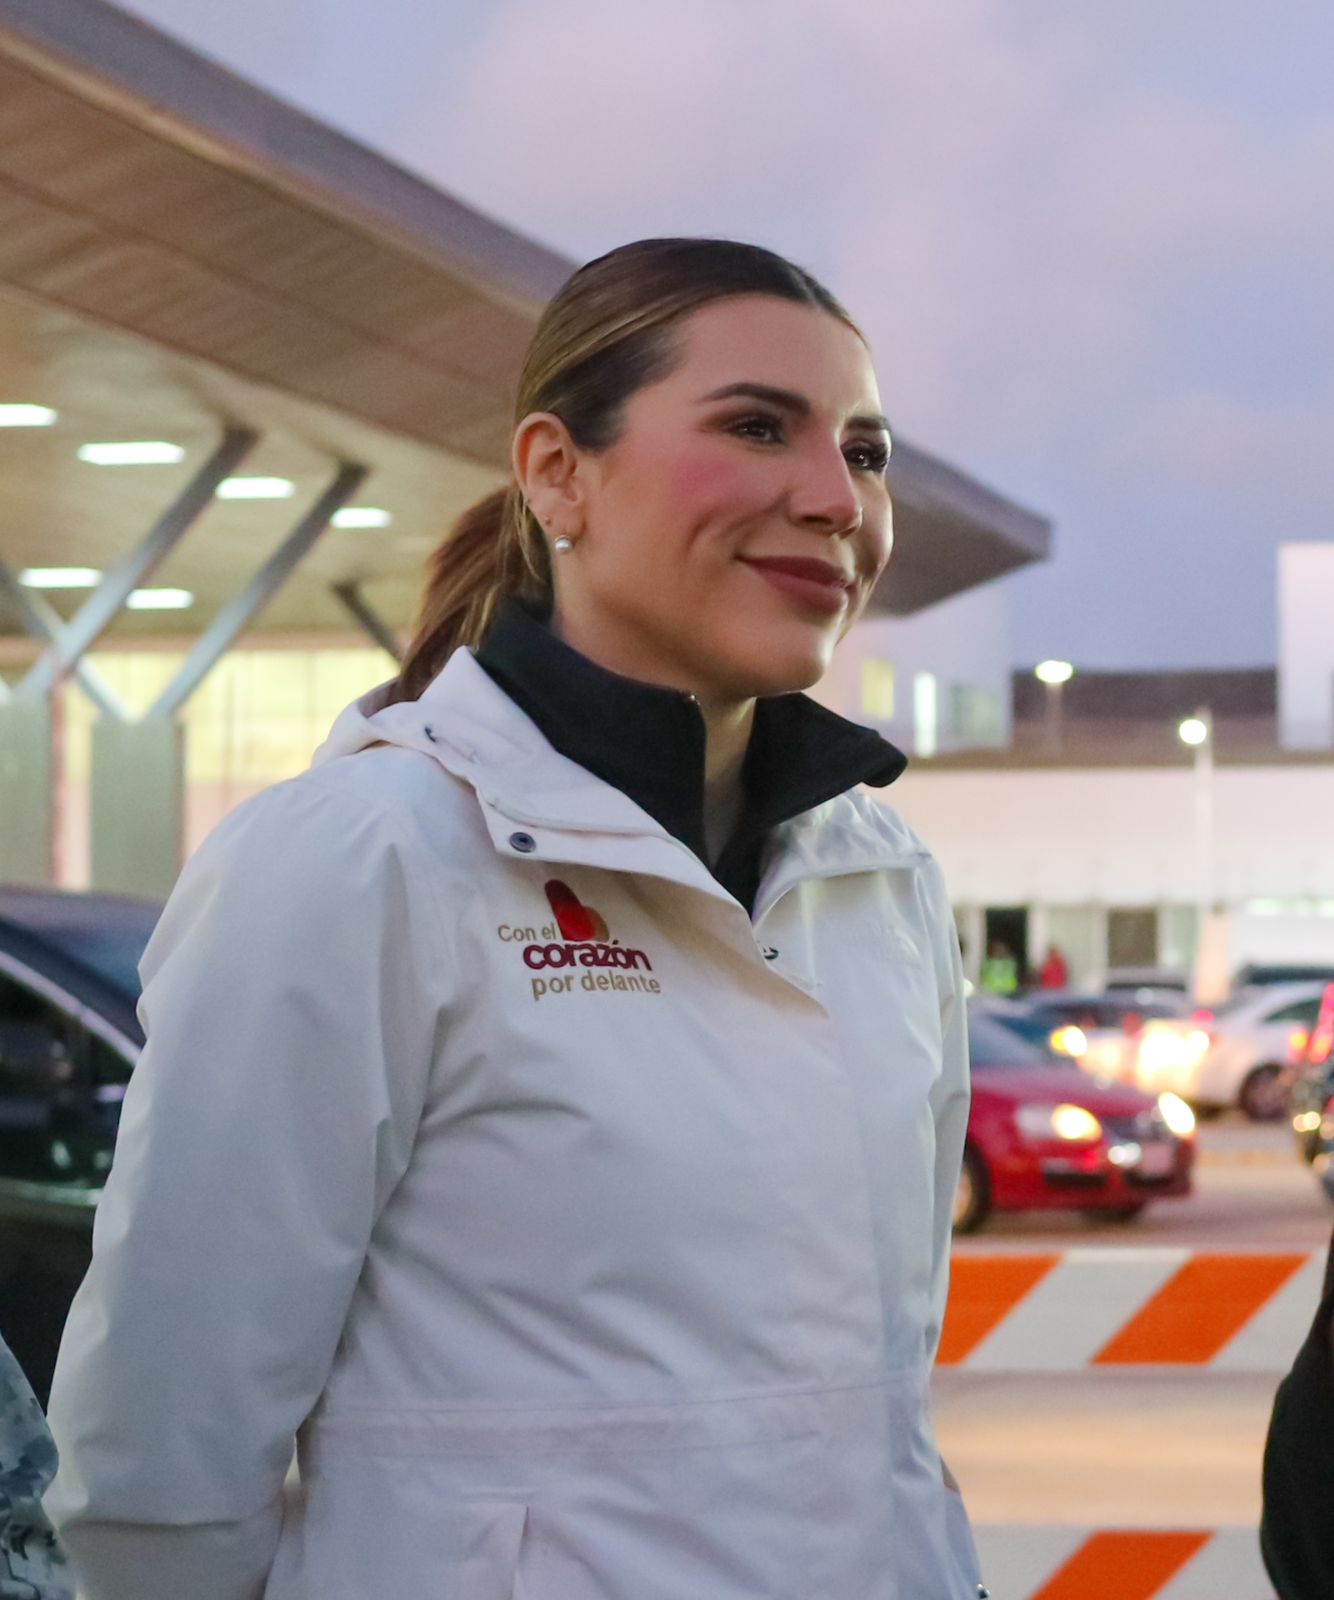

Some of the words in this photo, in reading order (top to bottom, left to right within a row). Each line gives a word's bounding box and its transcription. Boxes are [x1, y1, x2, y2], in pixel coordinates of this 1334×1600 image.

[497, 924, 537, 942] Con
[541, 922, 556, 940] el
[522, 939, 653, 971] corazón
[531, 975, 575, 1001] por
[580, 970, 662, 994] delante
